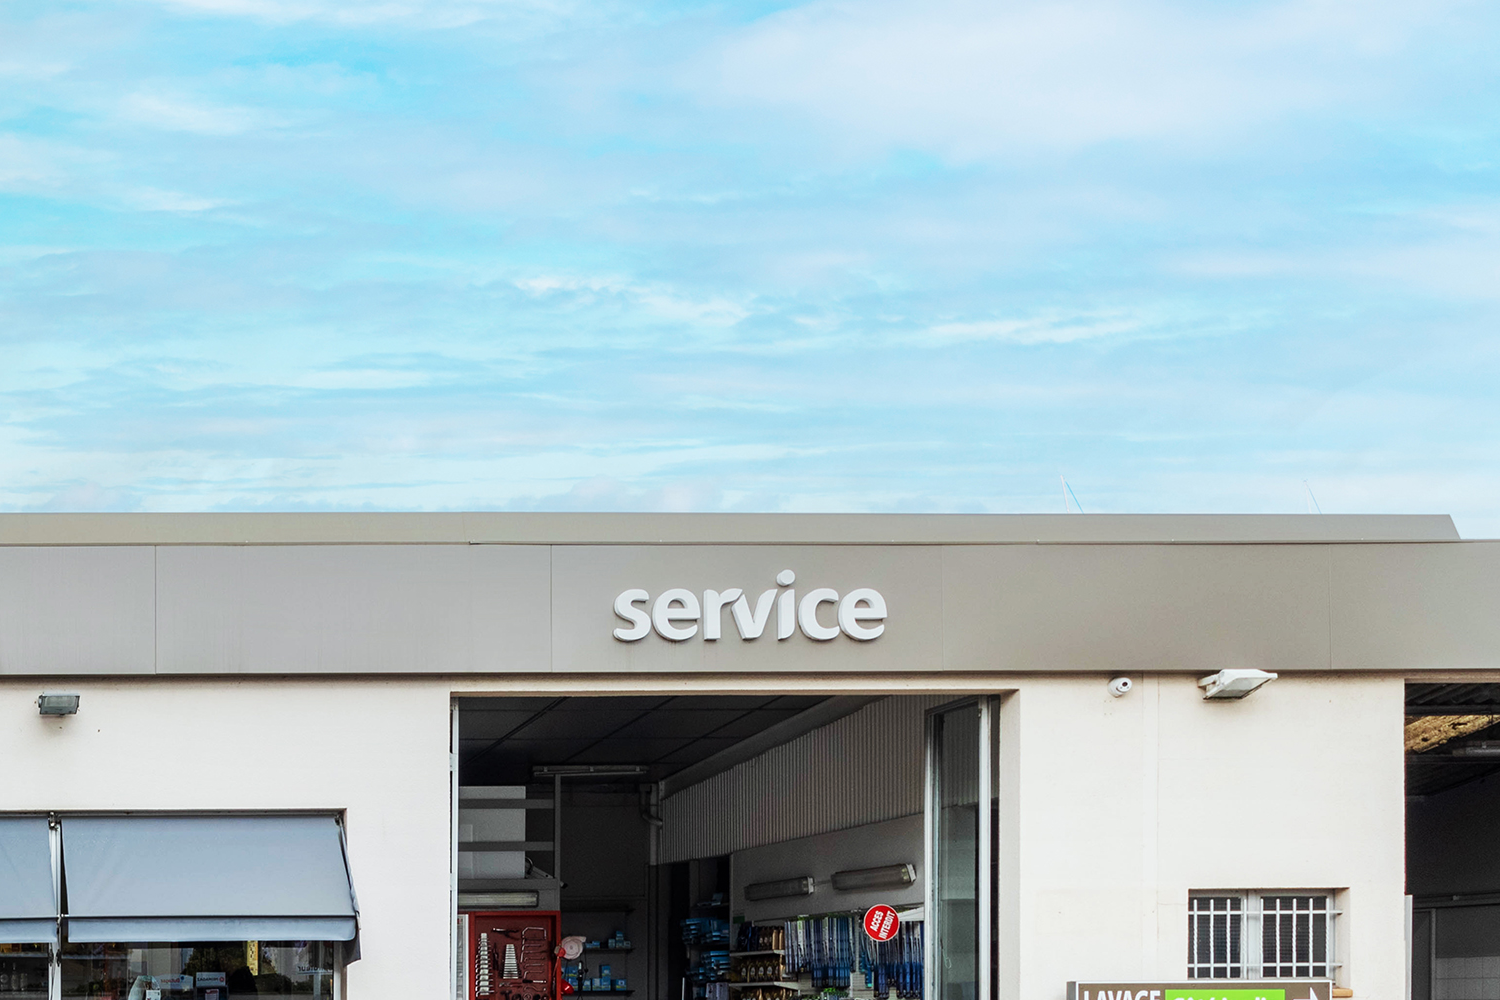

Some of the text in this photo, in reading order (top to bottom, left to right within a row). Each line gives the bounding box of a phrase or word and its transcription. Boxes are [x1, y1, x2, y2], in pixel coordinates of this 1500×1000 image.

[613, 569, 888, 642] service
[870, 910, 884, 932] ACCES
[878, 910, 895, 940] INTERDIT
